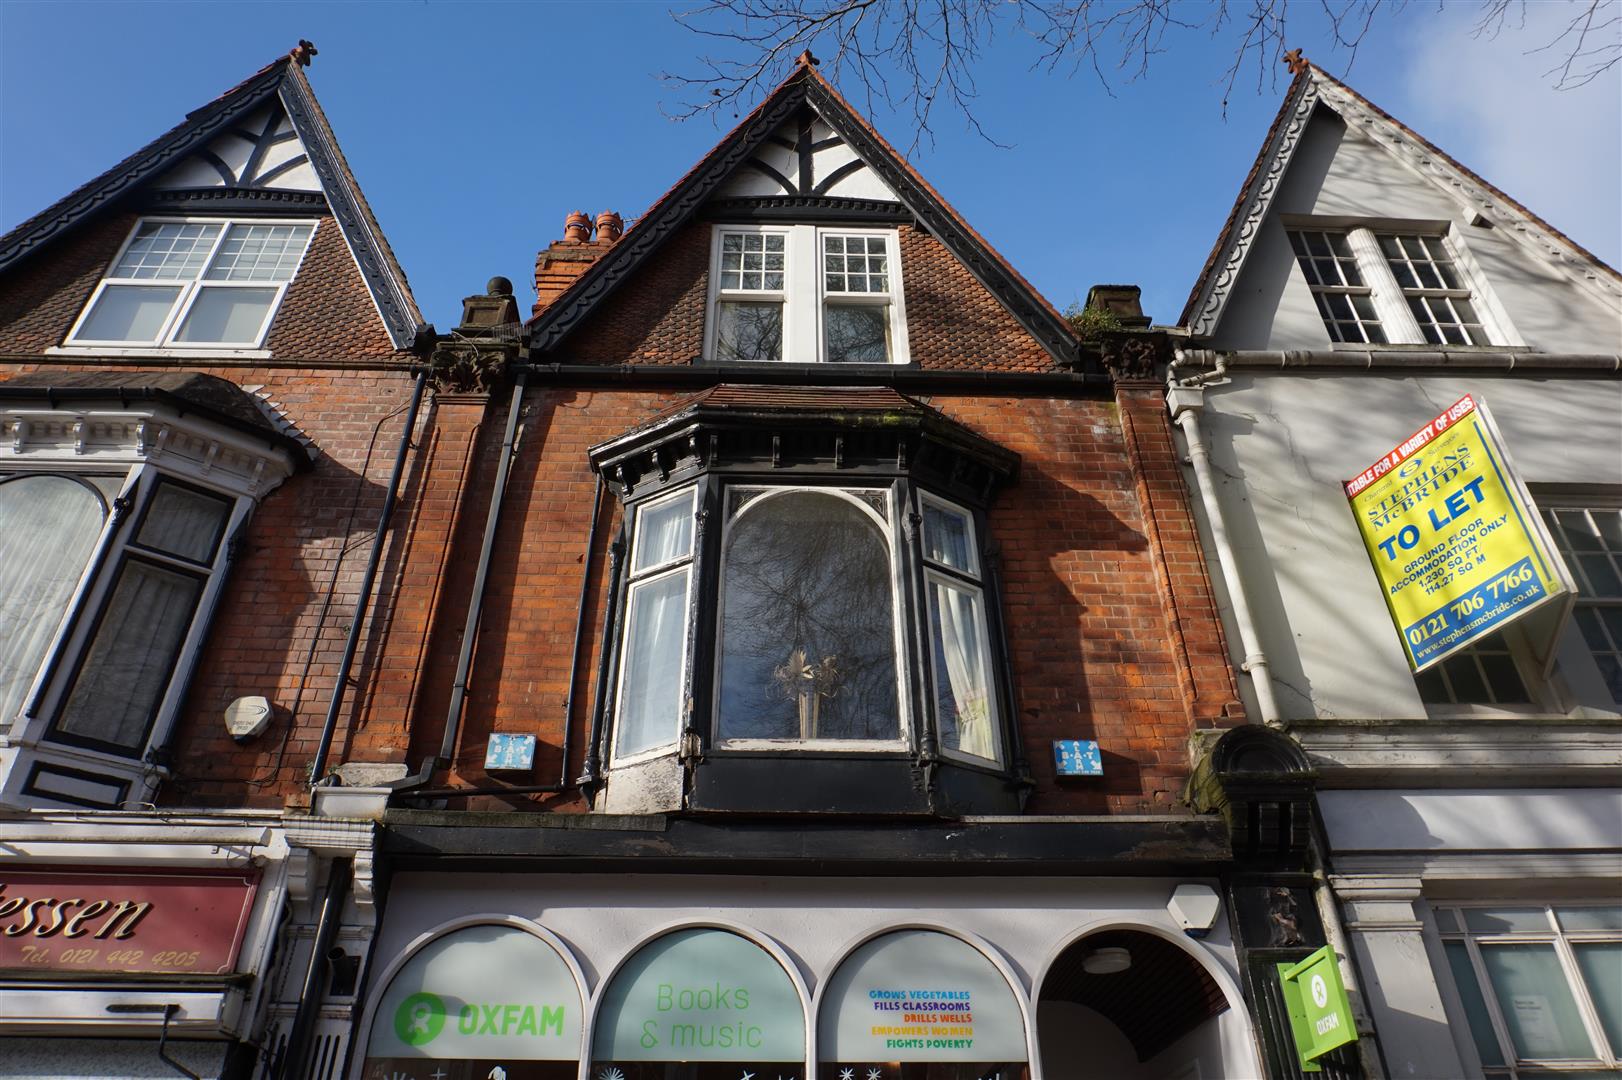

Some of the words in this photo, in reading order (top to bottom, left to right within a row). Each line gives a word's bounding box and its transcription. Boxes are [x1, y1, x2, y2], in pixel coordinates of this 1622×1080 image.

[1374, 457, 1392, 477] FOR
[1391, 451, 1401, 466] A
[1399, 424, 1434, 458] VARIETY
[1434, 414, 1449, 431] OF
[1448, 397, 1473, 421] USES
[1368, 443, 1469, 519] STEPHENS
[1372, 455, 1475, 532] McBRIDE
[1378, 524, 1420, 561] TO
[1428, 475, 1485, 532] LET
[1391, 535, 1477, 595] ACCOMMODATION
[1479, 514, 1508, 537] ONLY
[1404, 543, 1446, 574] GROUND
[1448, 518, 1484, 545] FLOOR
[1419, 567, 1445, 588] 1,230
[1447, 556, 1463, 570] SQ
[1425, 573, 1454, 595] 114.27
[1458, 562, 1473, 575] SQ
[1476, 553, 1487, 565] M
[1410, 614, 1449, 645] 0121
[1450, 591, 1485, 620] 706
[1486, 562, 1533, 599] 7766
[1417, 584, 1540, 658] www.stephensmcbride.co.uk
[0, 883, 154, 940] essen
[21, 945, 50, 964] Tel.
[59, 949, 98, 964] 0121
[106, 950, 144, 966] 442
[152, 951, 200, 967] 4205
[656, 982, 750, 1012] Books
[869, 990, 907, 1000] GROWS
[909, 990, 970, 1000] VEGETABLES
[874, 1001, 900, 1011] FILLS
[902, 1001, 971, 1011] CLASSROOMS
[458, 1004, 566, 1037] OXFAM
[640, 1019, 660, 1049] &
[670, 1020, 763, 1049] music
[871, 1026, 929, 1036] EMPOWERS
[931, 1026, 973, 1036] WOMEN
[904, 1013, 937, 1023] DRILLS
[939, 1013, 973, 1023] WELLS
[1316, 1012, 1340, 1036] OXFAM
[886, 1039, 924, 1049] FIGHTS
[926, 1039, 973, 1049] POVERTY
